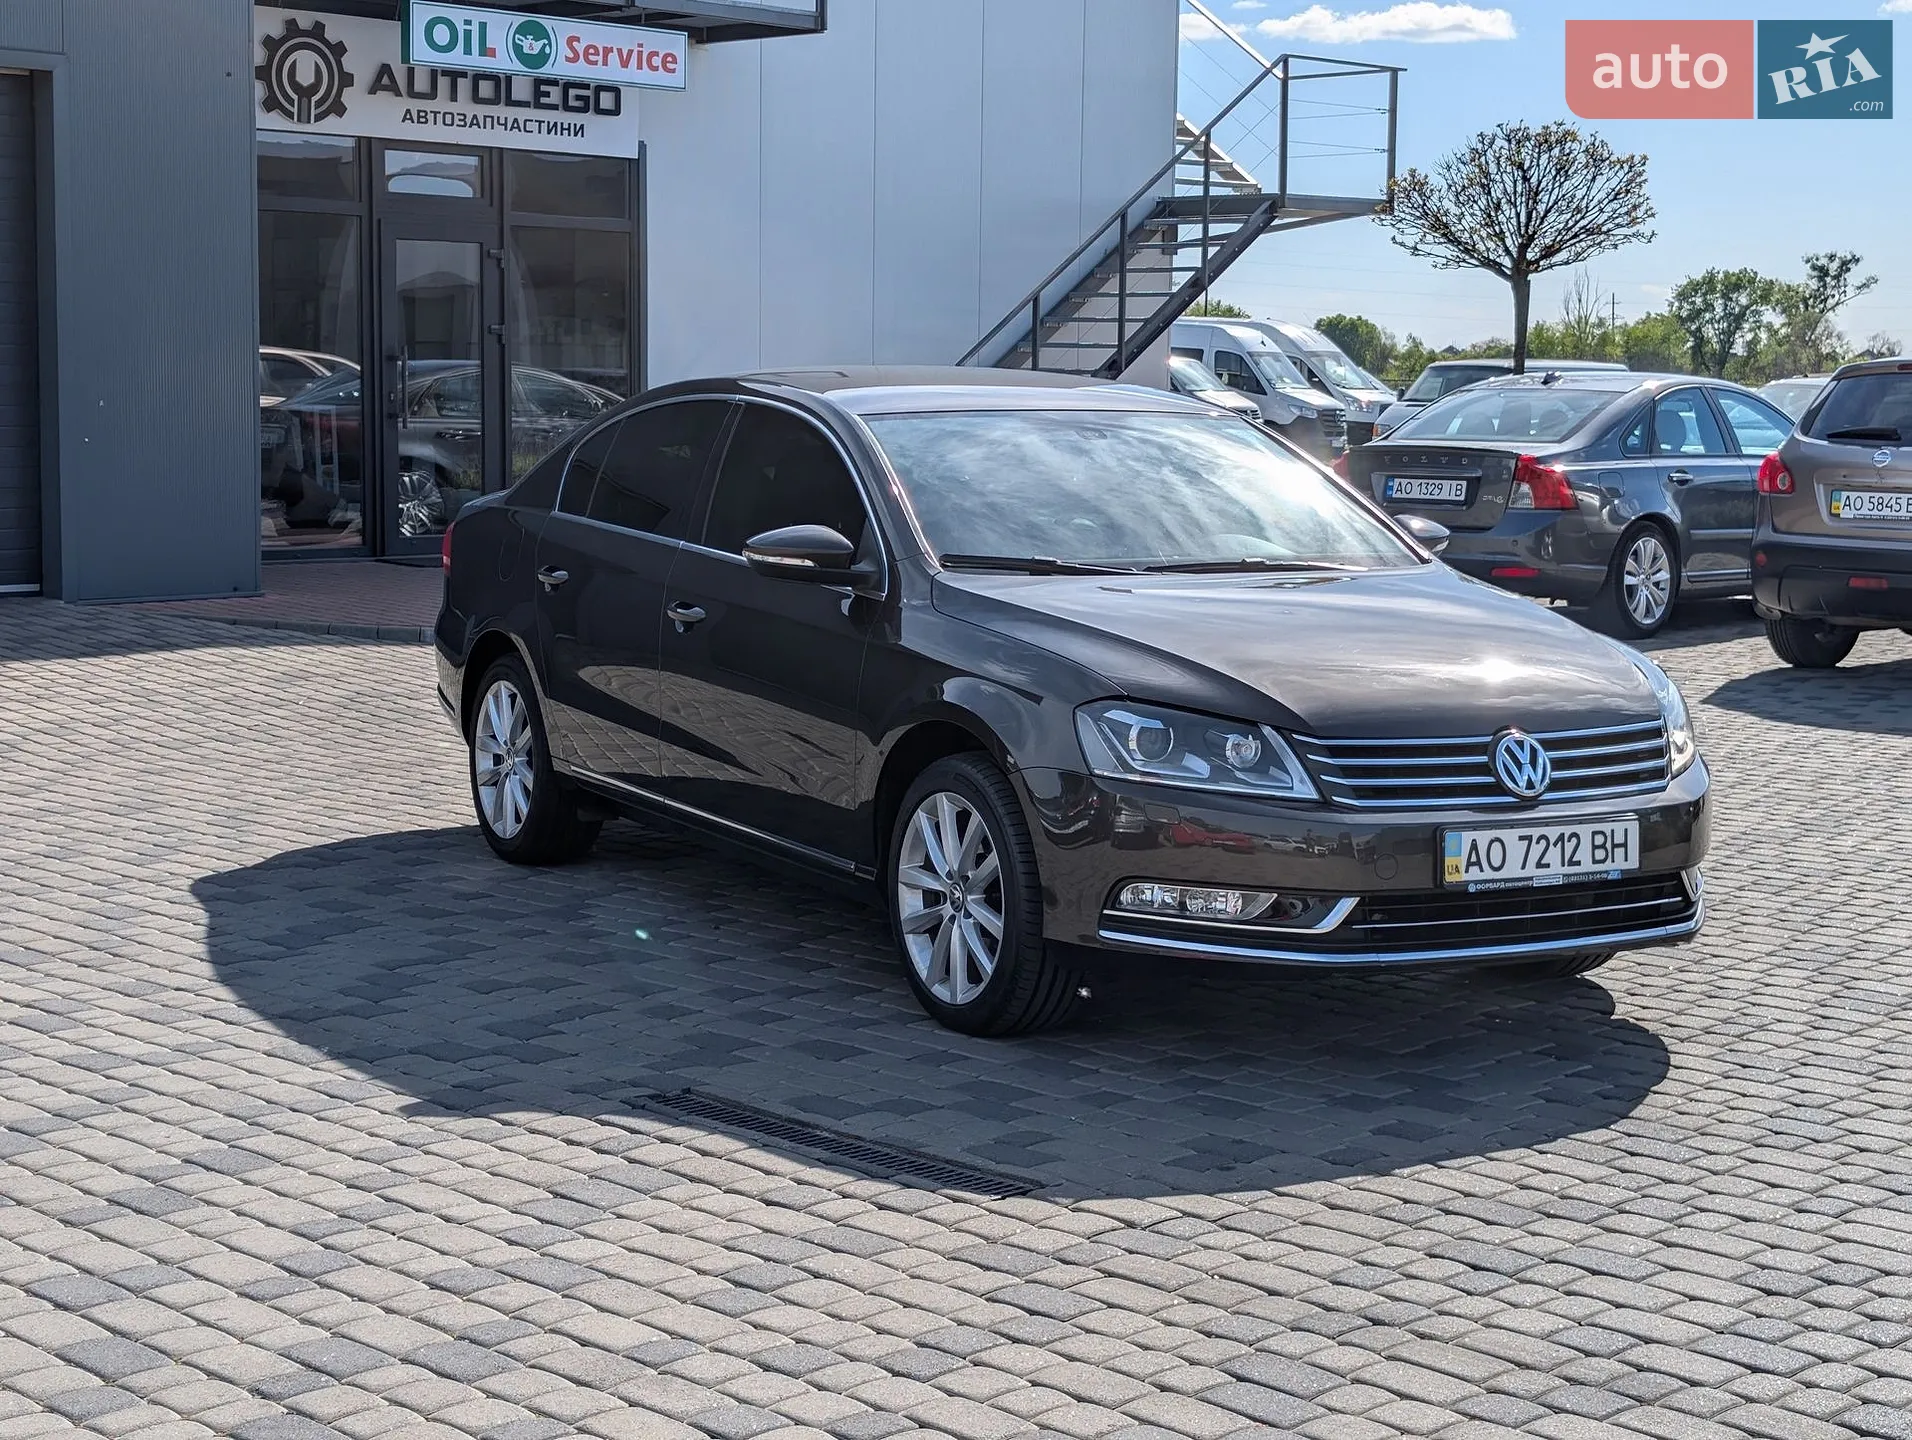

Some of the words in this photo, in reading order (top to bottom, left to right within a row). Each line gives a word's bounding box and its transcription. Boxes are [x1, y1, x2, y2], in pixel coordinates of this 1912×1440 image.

[564, 35, 678, 74] Service
[367, 63, 622, 117] AUTOLEGO
[401, 108, 586, 138] АВТОЗАПЧАСТИНИ
[1416, 481, 1443, 496] 1329
[1842, 495, 1864, 511] AO
[1867, 496, 1902, 513] 5845
[1464, 837, 1507, 874] AO
[1518, 831, 1582, 871] 7212
[1591, 828, 1629, 865] BH
[1446, 864, 1460, 876] UA
